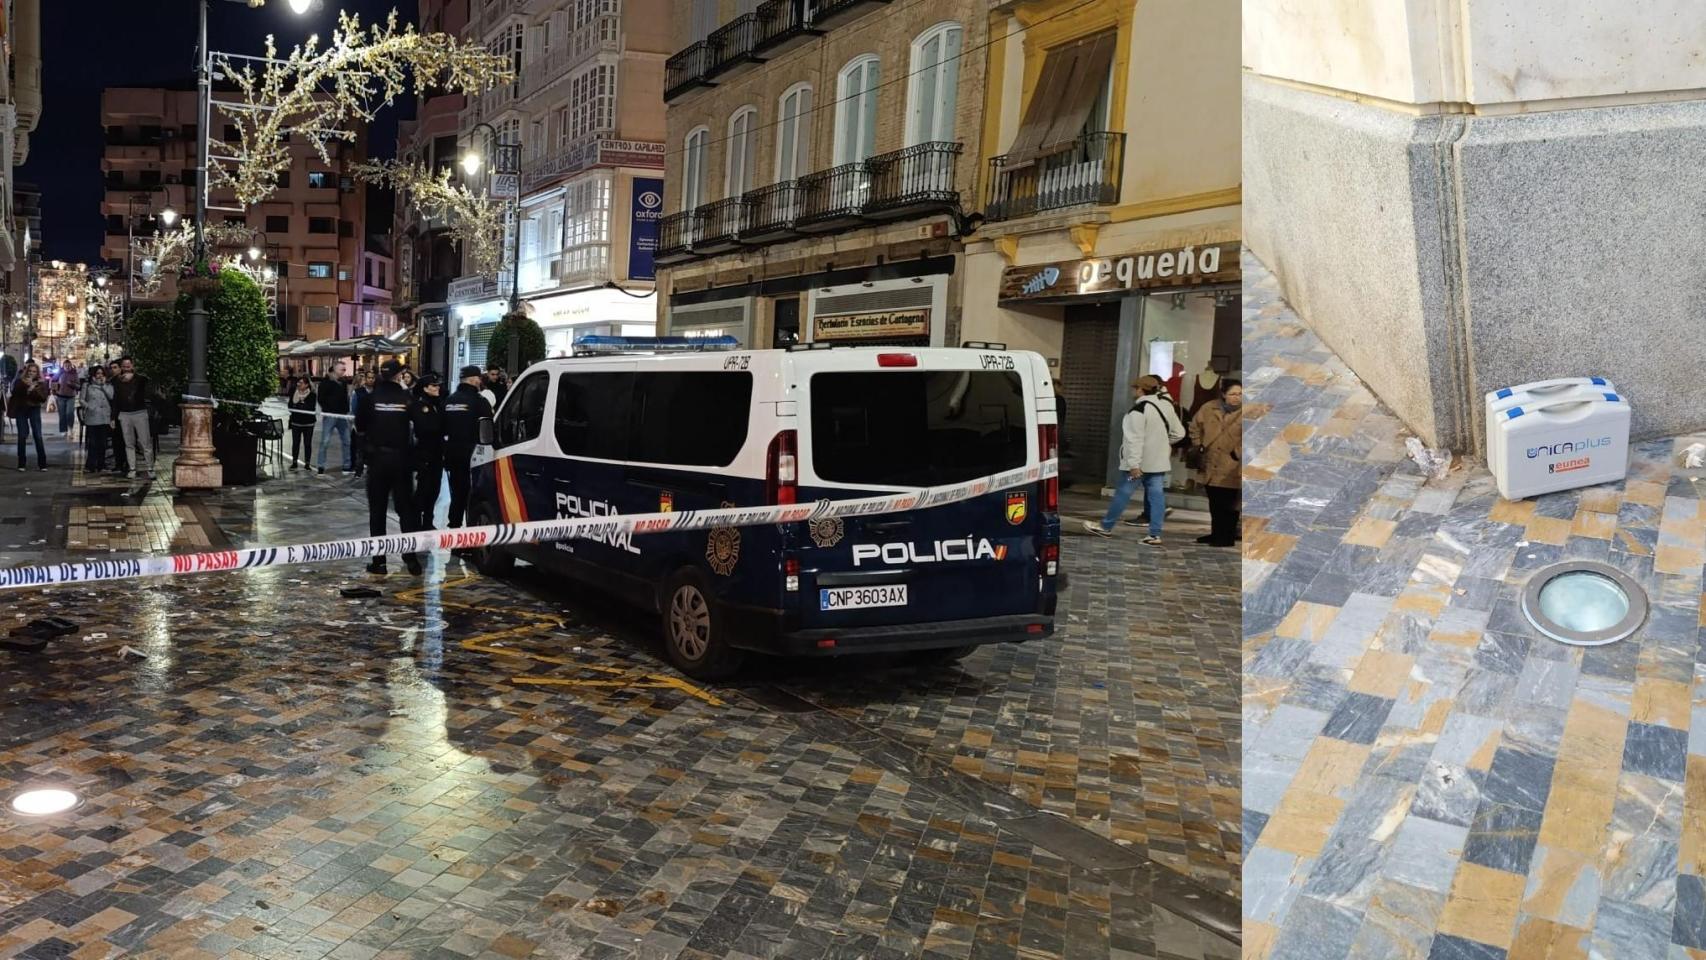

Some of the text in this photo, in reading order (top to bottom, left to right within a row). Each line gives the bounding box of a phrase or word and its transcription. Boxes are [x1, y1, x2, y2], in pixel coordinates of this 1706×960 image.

[601, 140, 666, 153] CENTROS CAPILARES
[1079, 246, 1220, 293] pequeña
[880, 315, 888, 325] de
[889, 312, 925, 326] Cartagena
[979, 354, 1015, 370] UPR-72B
[60, 562, 78, 581] DE
[84, 559, 141, 580] POLICIA
[172, 556, 192, 572] NO
[197, 552, 239, 571] PASAR
[302, 541, 357, 562] NACIONAL
[361, 540, 375, 556] DE
[377, 536, 417, 555] POLICIA
[439, 533, 454, 549] NO
[456, 531, 487, 548] PASAR
[532, 525, 573, 541] NACIONAL
[852, 534, 996, 566] POLICÍA
